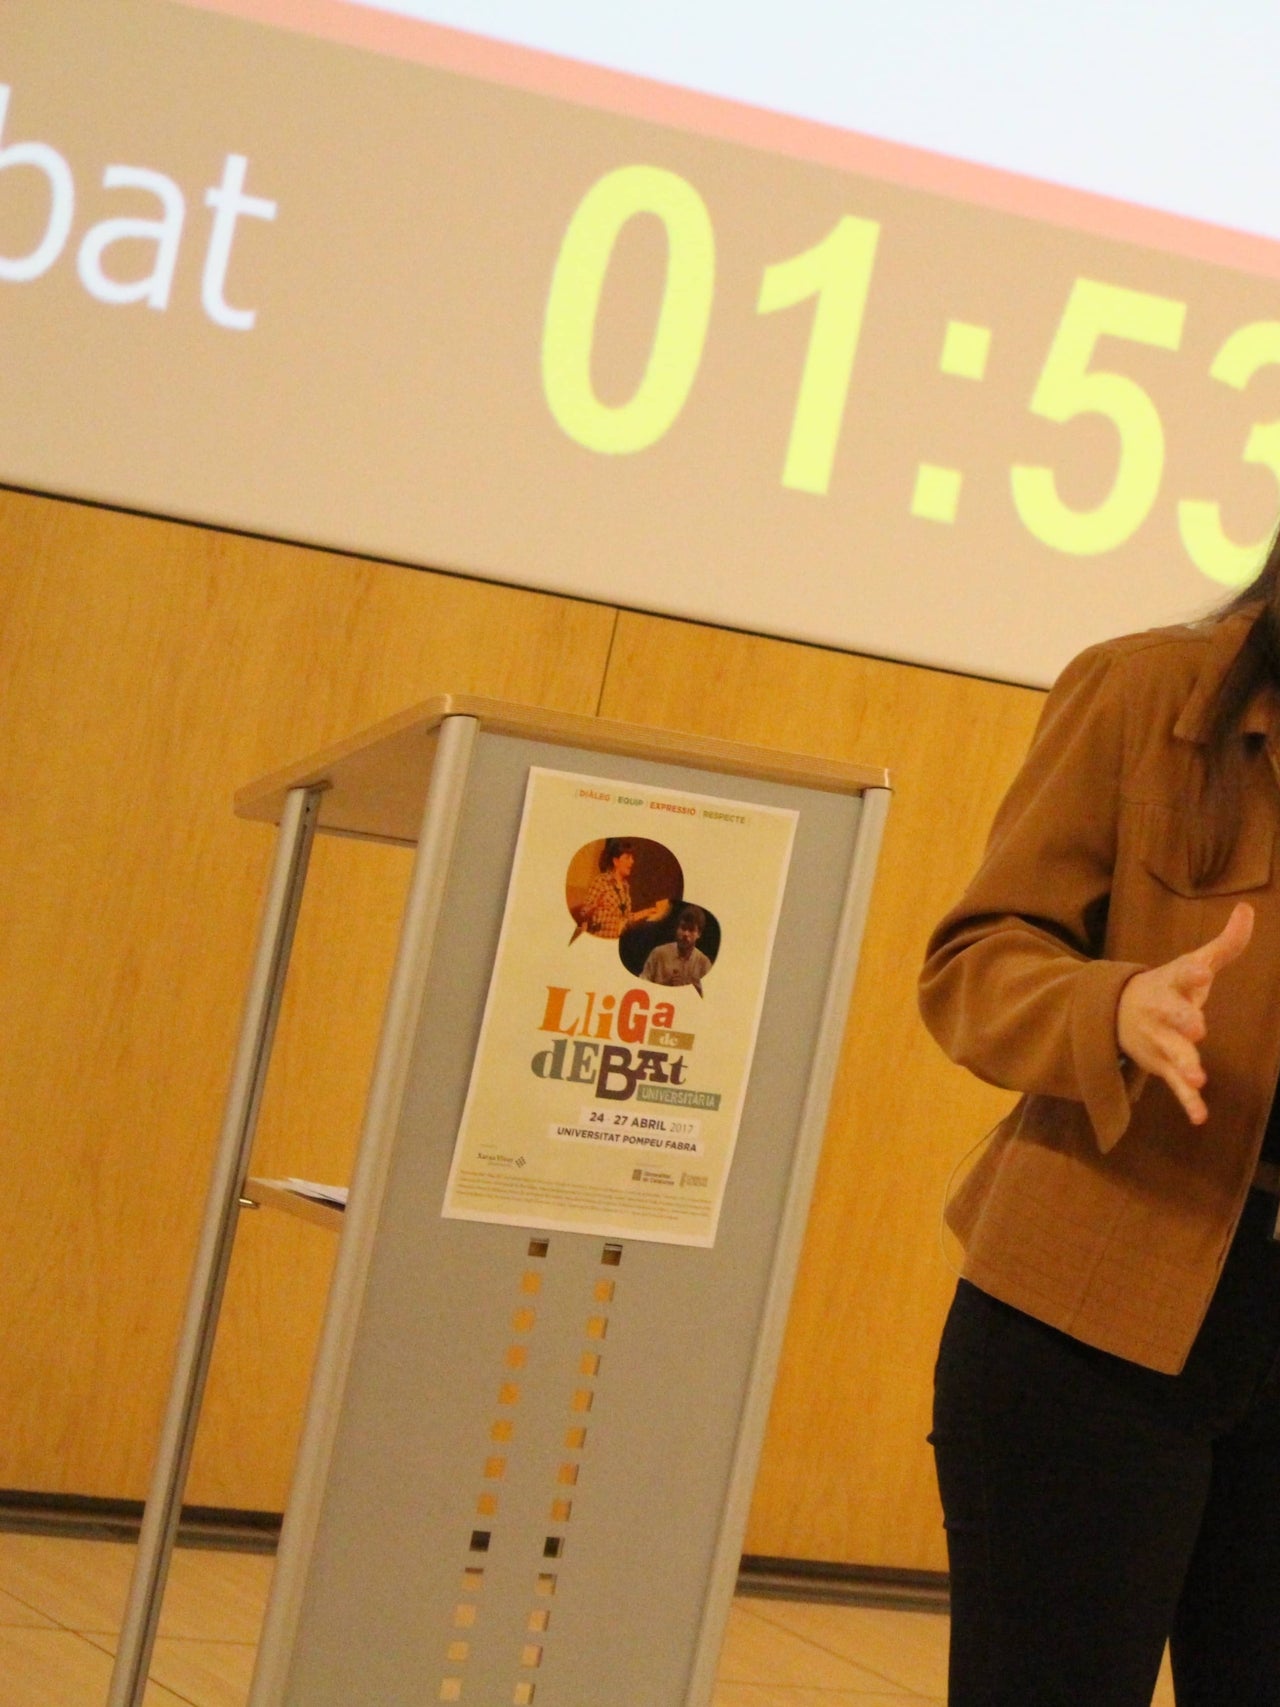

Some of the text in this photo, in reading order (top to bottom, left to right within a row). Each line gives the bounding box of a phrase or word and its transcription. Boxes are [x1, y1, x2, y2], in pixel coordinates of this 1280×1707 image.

[617, 796, 644, 807] EQUIP
[702, 809, 746, 825] RESPECTE
[659, 1031, 678, 1048] de
[589, 1111, 694, 1134] 24 27 ABRIL 2017
[556, 1127, 697, 1152] UNIVERSITAT POMPEU FABRA
